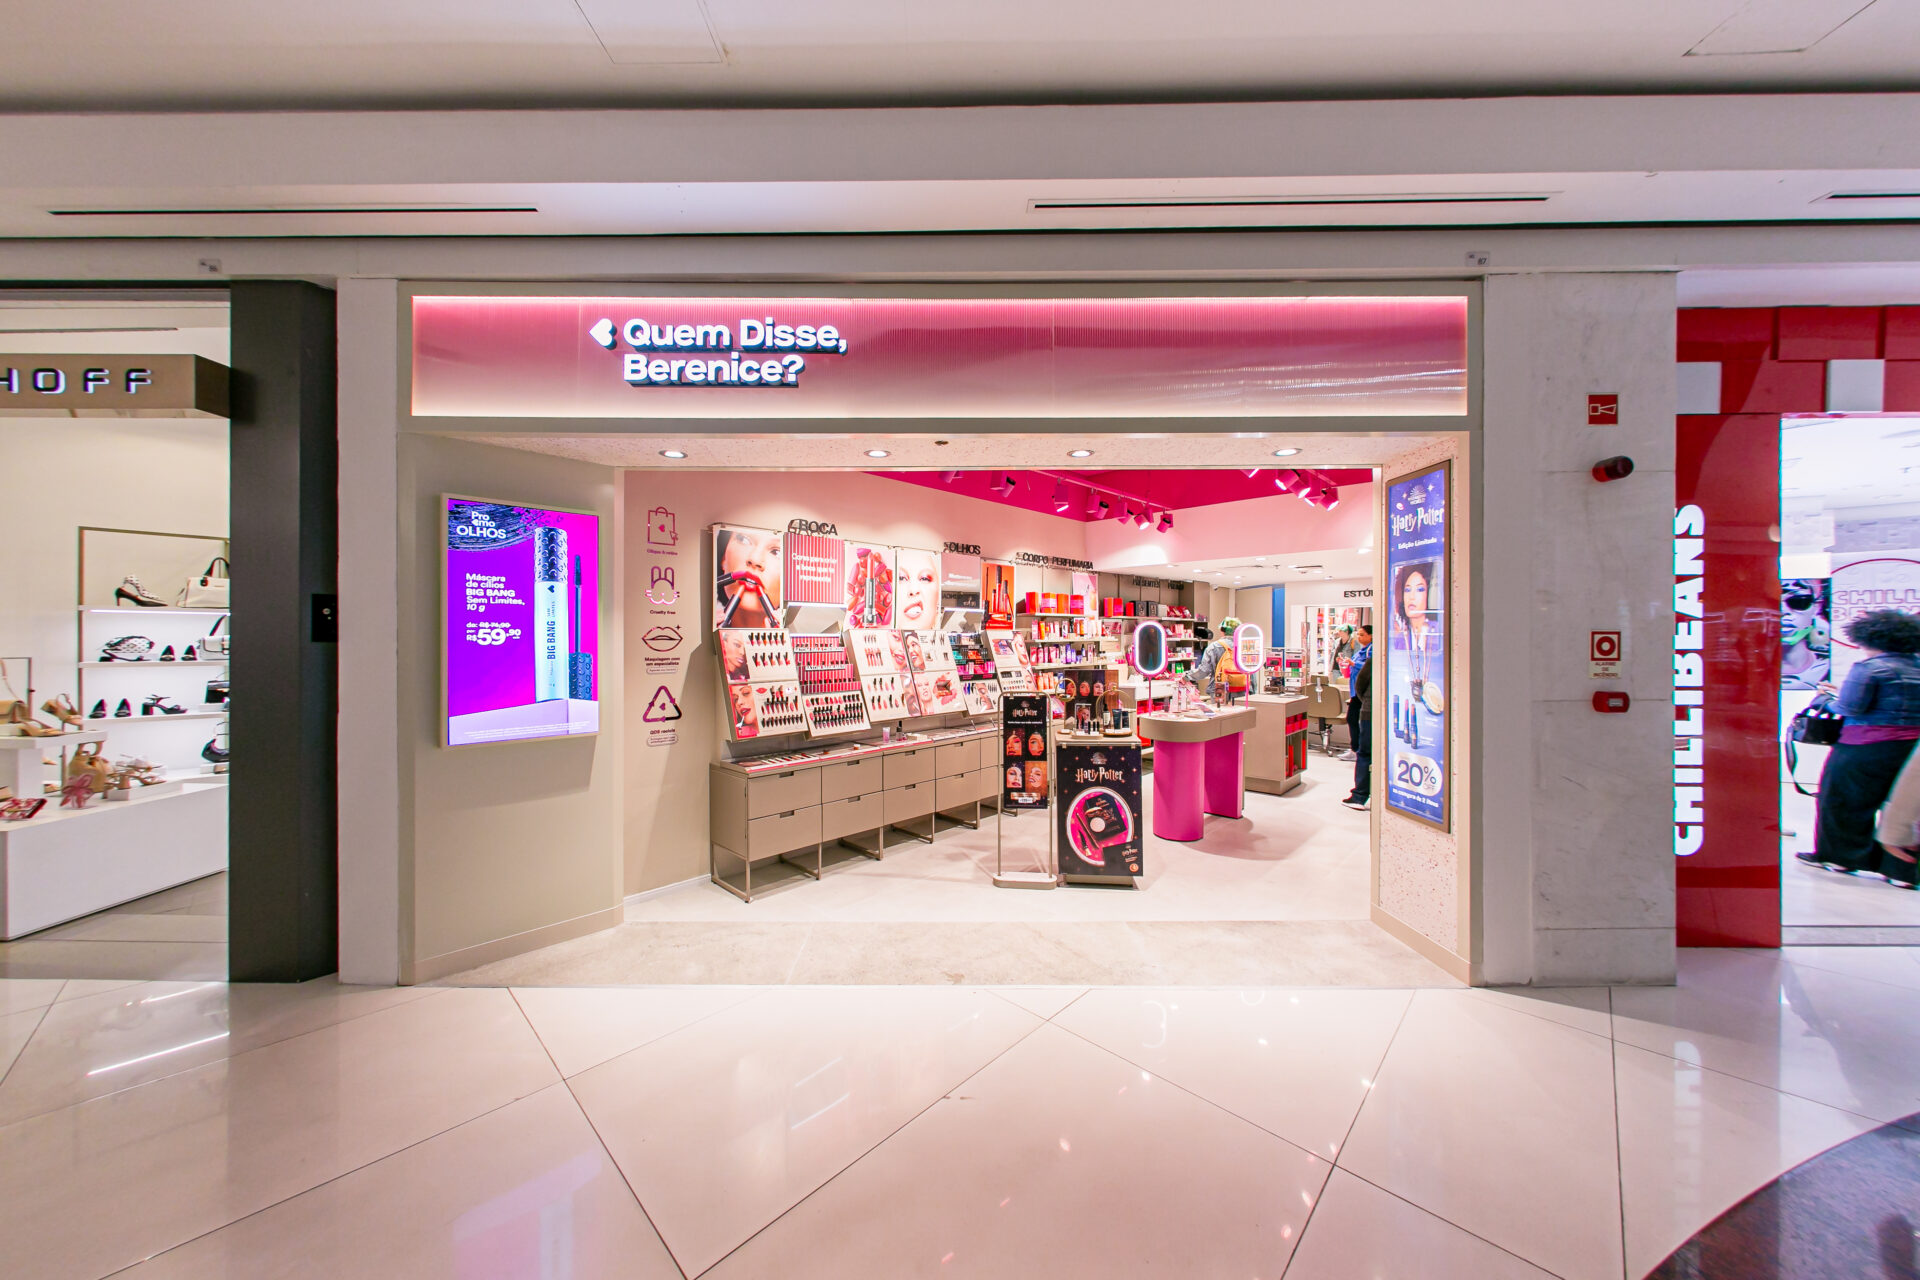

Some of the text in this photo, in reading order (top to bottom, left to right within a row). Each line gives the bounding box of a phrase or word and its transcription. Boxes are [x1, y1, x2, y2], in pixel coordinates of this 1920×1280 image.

[623, 317, 848, 353] Quem Disse,
[623, 351, 805, 385] Berenice?
[471, 511, 490, 521] Pro
[1391, 507, 1444, 536] Harry Potter
[456, 525, 507, 539] OLHOS
[799, 519, 838, 536] BOCA
[949, 542, 981, 555] OLHOS
[1022, 553, 1094, 570] CORPO PERFUMARIA
[465, 572, 506, 582] Máscara
[465, 588, 516, 597] BIG BANG
[1343, 588, 1373, 598] ESTÚ
[466, 596, 526, 606] Sem Limites,
[478, 605, 486, 613] g
[547, 621, 555, 643] BANG
[547, 645, 555, 660] BIG
[1075, 766, 1124, 783] Harry Potter
[1398, 760, 1436, 787] 20%
